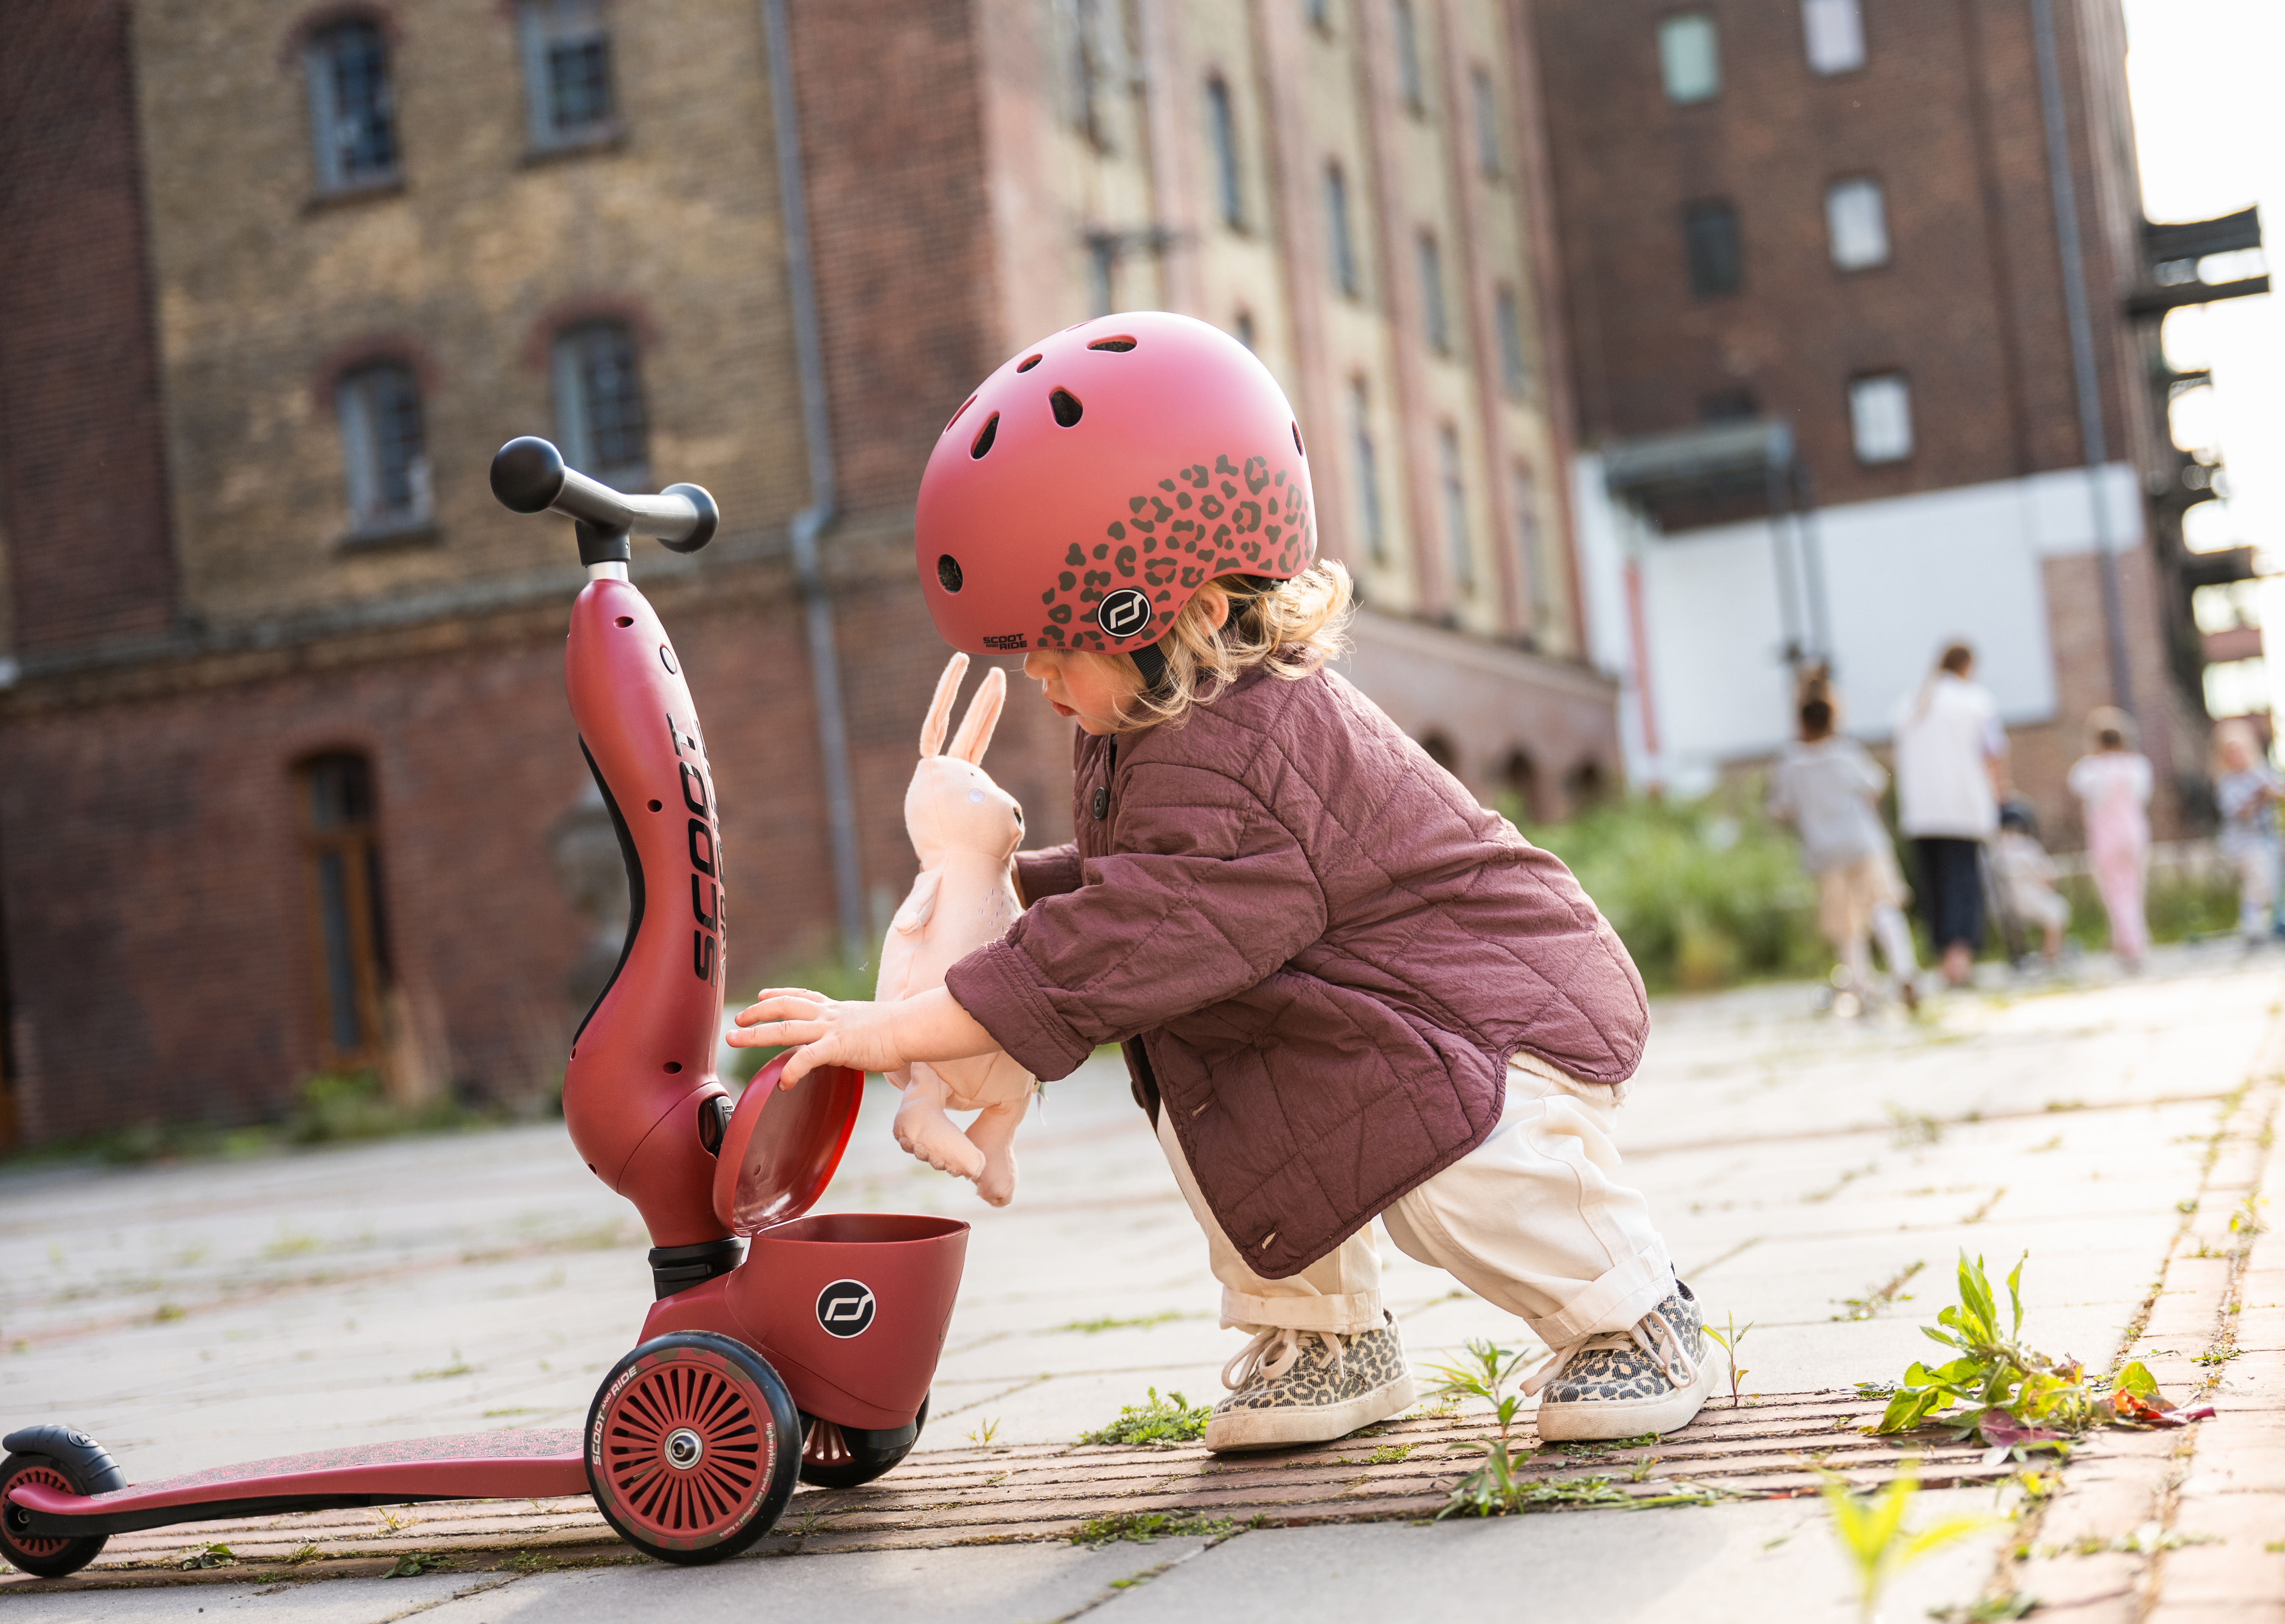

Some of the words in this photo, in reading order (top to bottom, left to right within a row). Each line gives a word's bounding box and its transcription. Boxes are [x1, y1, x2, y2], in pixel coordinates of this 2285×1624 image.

[983, 633, 1024, 644] SCOOT
[999, 640, 1027, 650] RIDE
[666, 713, 717, 987] SCOOT
[593, 1411, 605, 1466] SCOOT
[601, 1393, 612, 1411] AND
[611, 1365, 637, 1396] RIDE
[766, 1422, 775, 1467] Highwaykick
[761, 1468, 771, 1491] designed
[739, 1501, 758, 1523] developed
[719, 1525, 735, 1537] Austria
